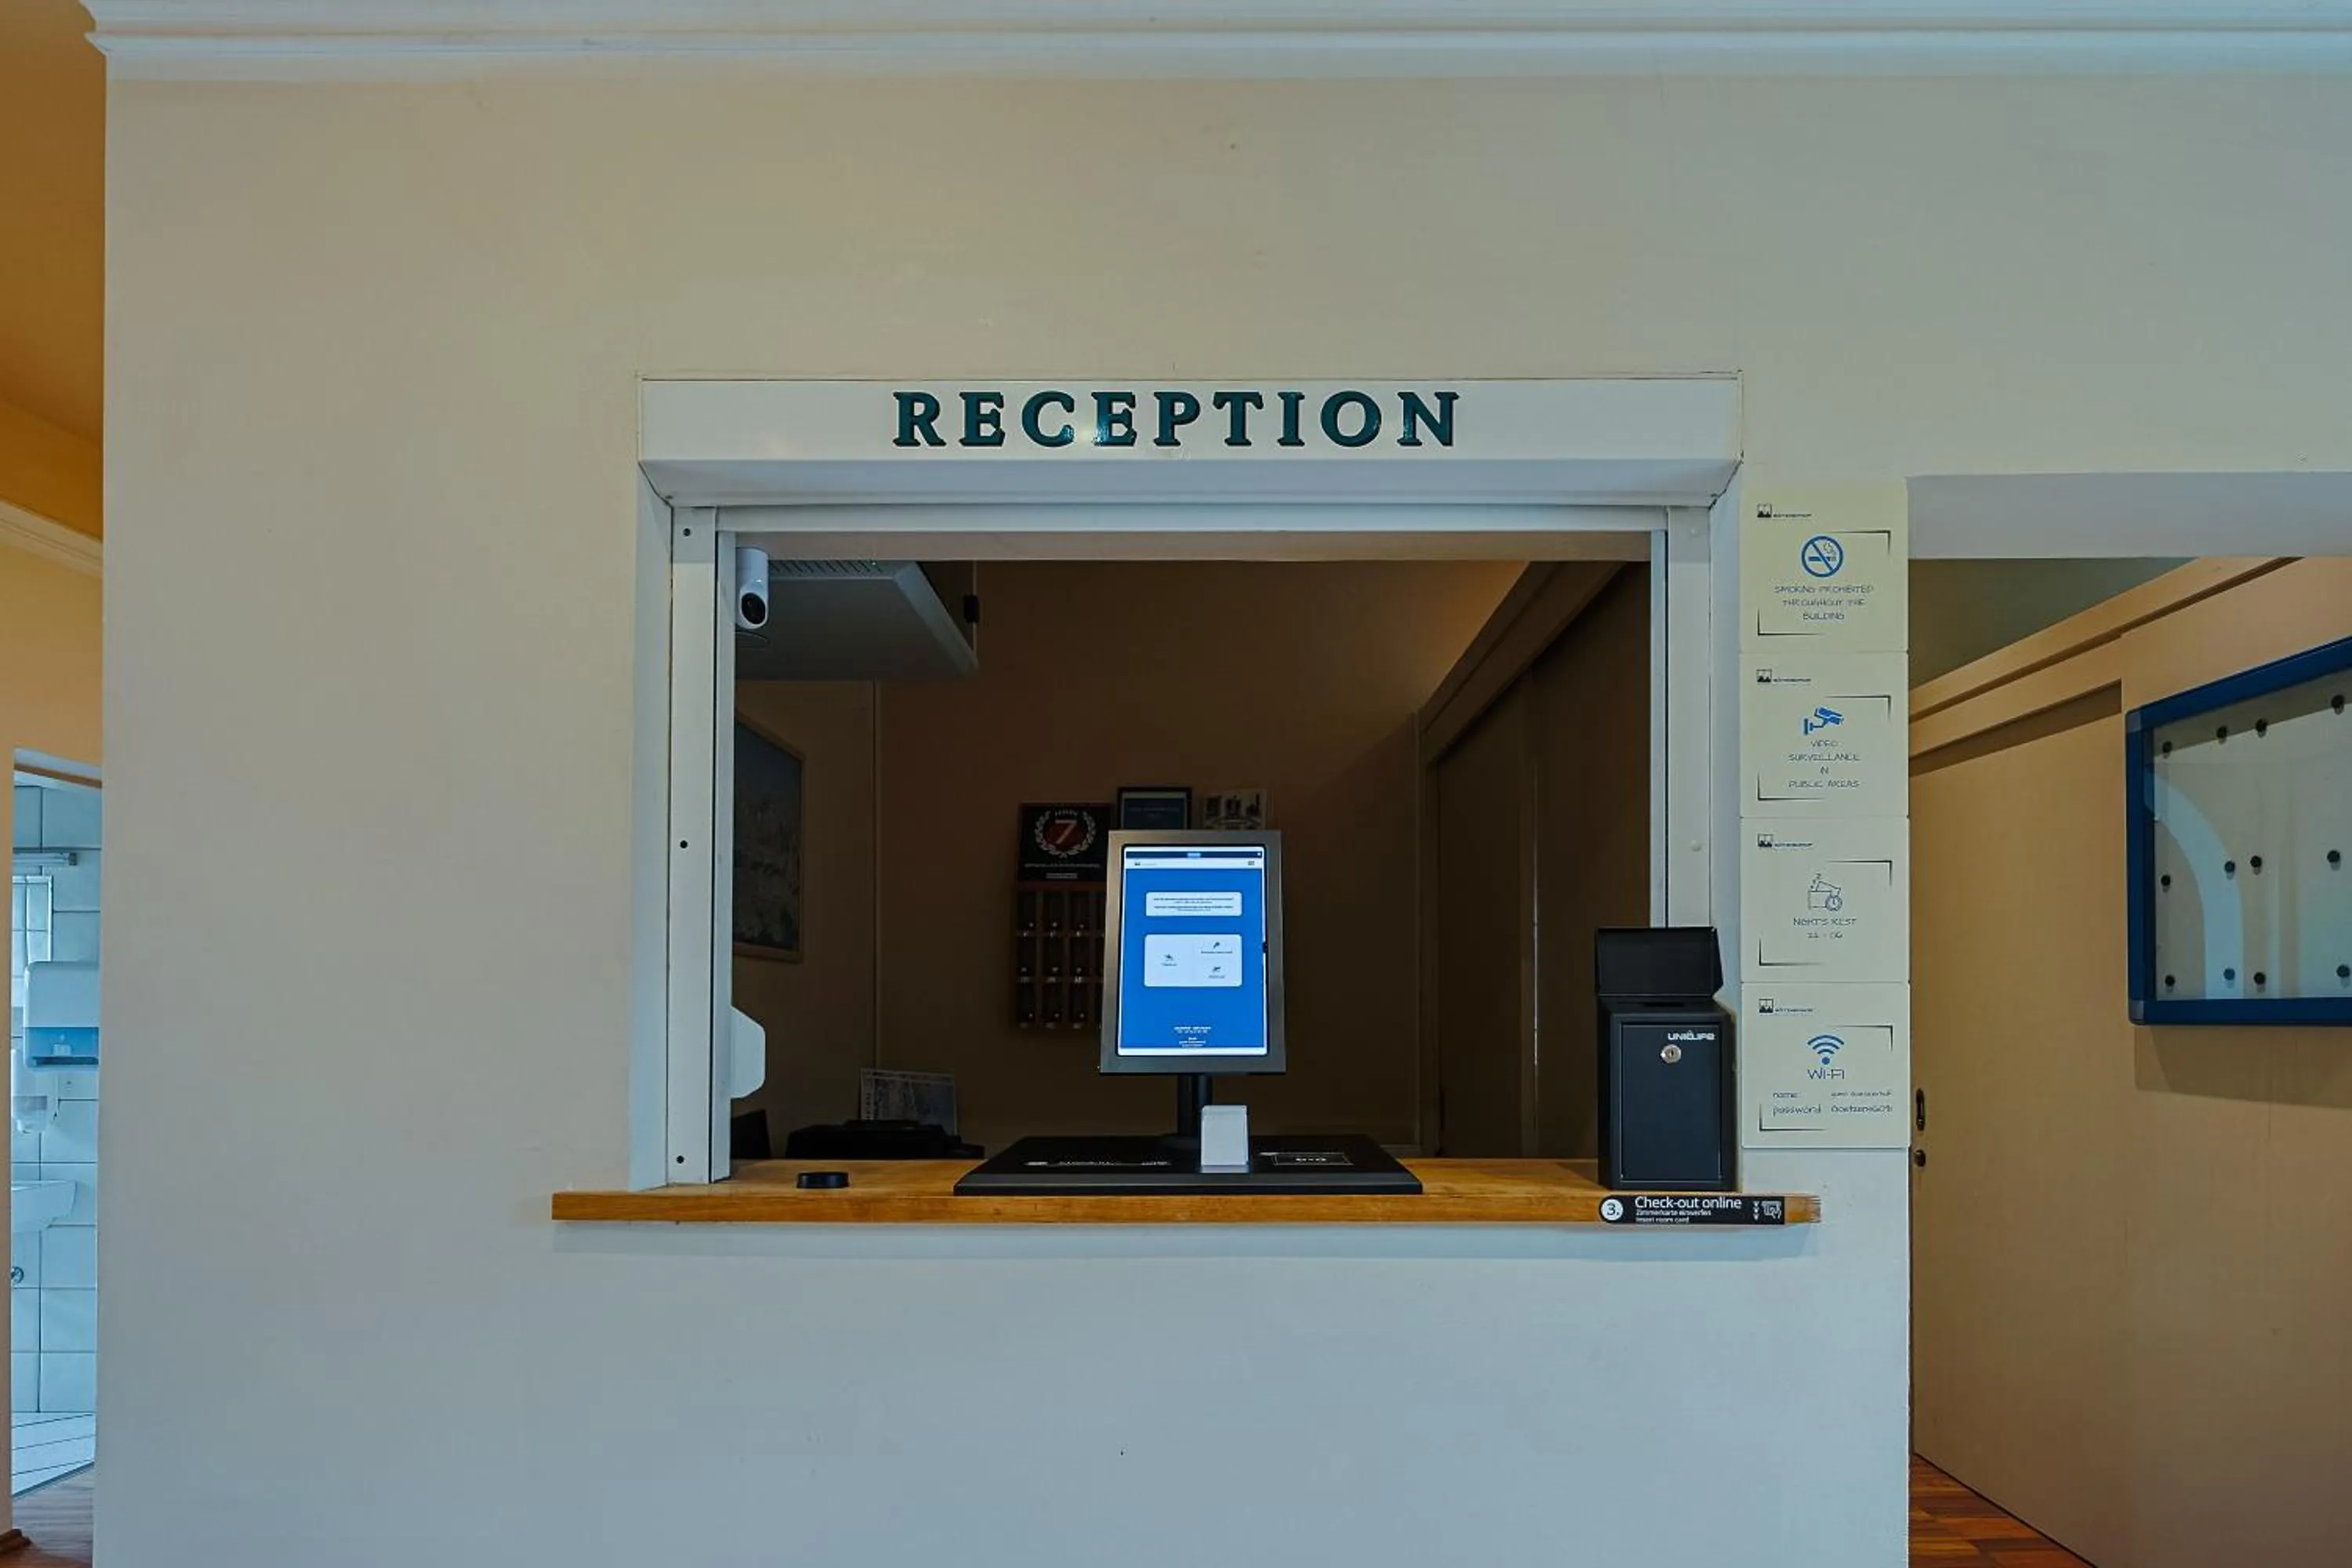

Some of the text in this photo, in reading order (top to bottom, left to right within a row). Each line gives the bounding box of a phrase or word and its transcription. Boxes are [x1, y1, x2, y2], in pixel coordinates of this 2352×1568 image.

[892, 391, 1459, 448] RECEPTION
[1635, 1196, 1742, 1208] Check-out online
